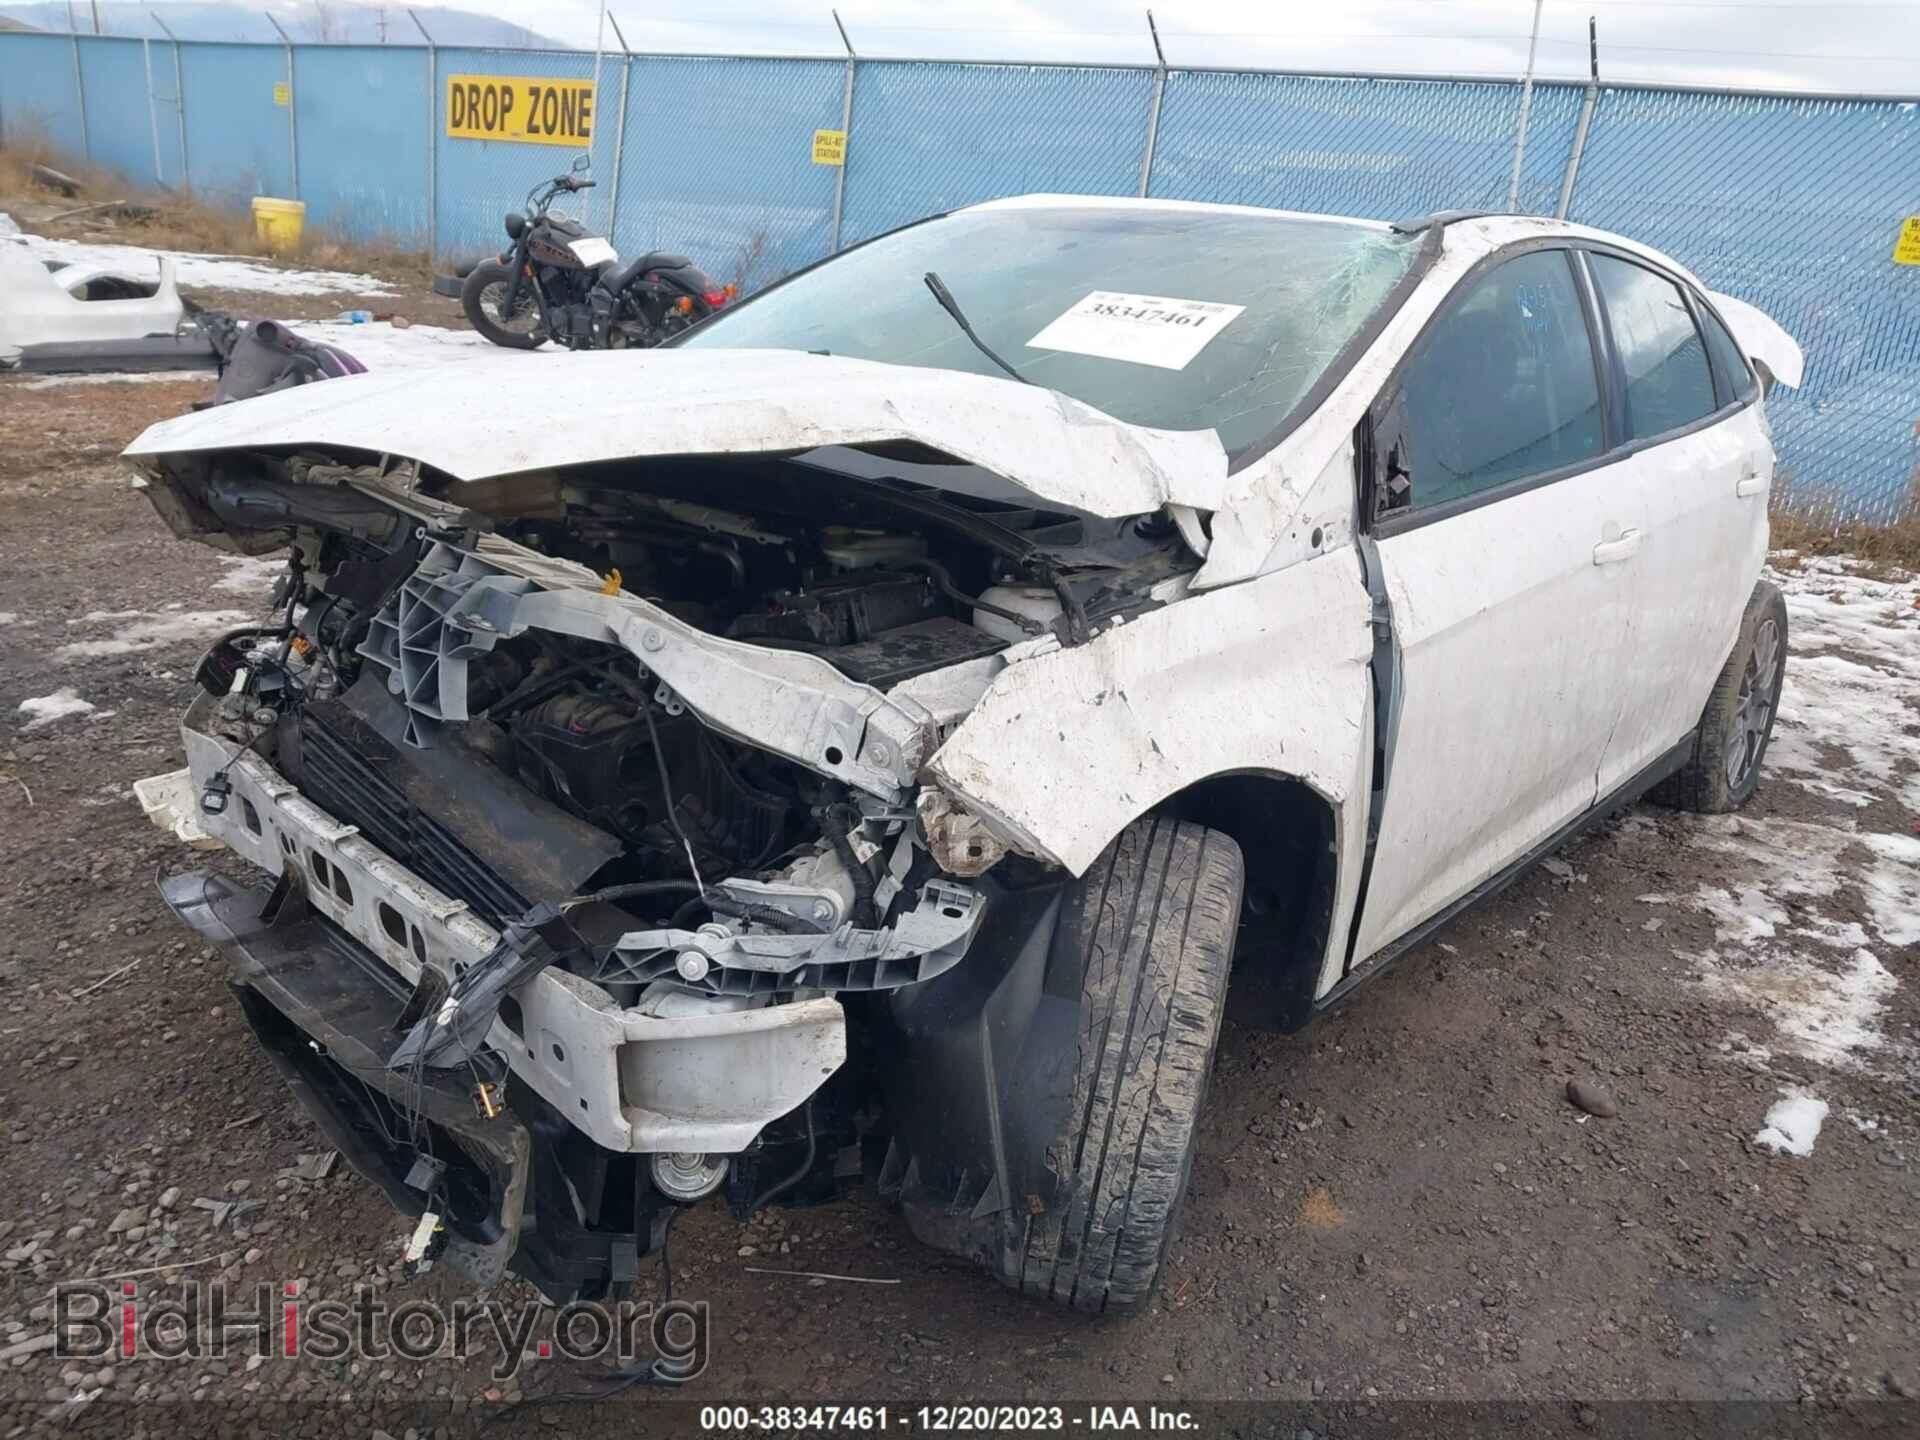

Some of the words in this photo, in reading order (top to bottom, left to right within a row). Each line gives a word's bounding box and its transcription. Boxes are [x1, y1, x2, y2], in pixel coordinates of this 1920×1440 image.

[452, 82, 514, 131] DROP
[527, 86, 592, 137] ZONE
[1084, 303, 1208, 327] 38347461
